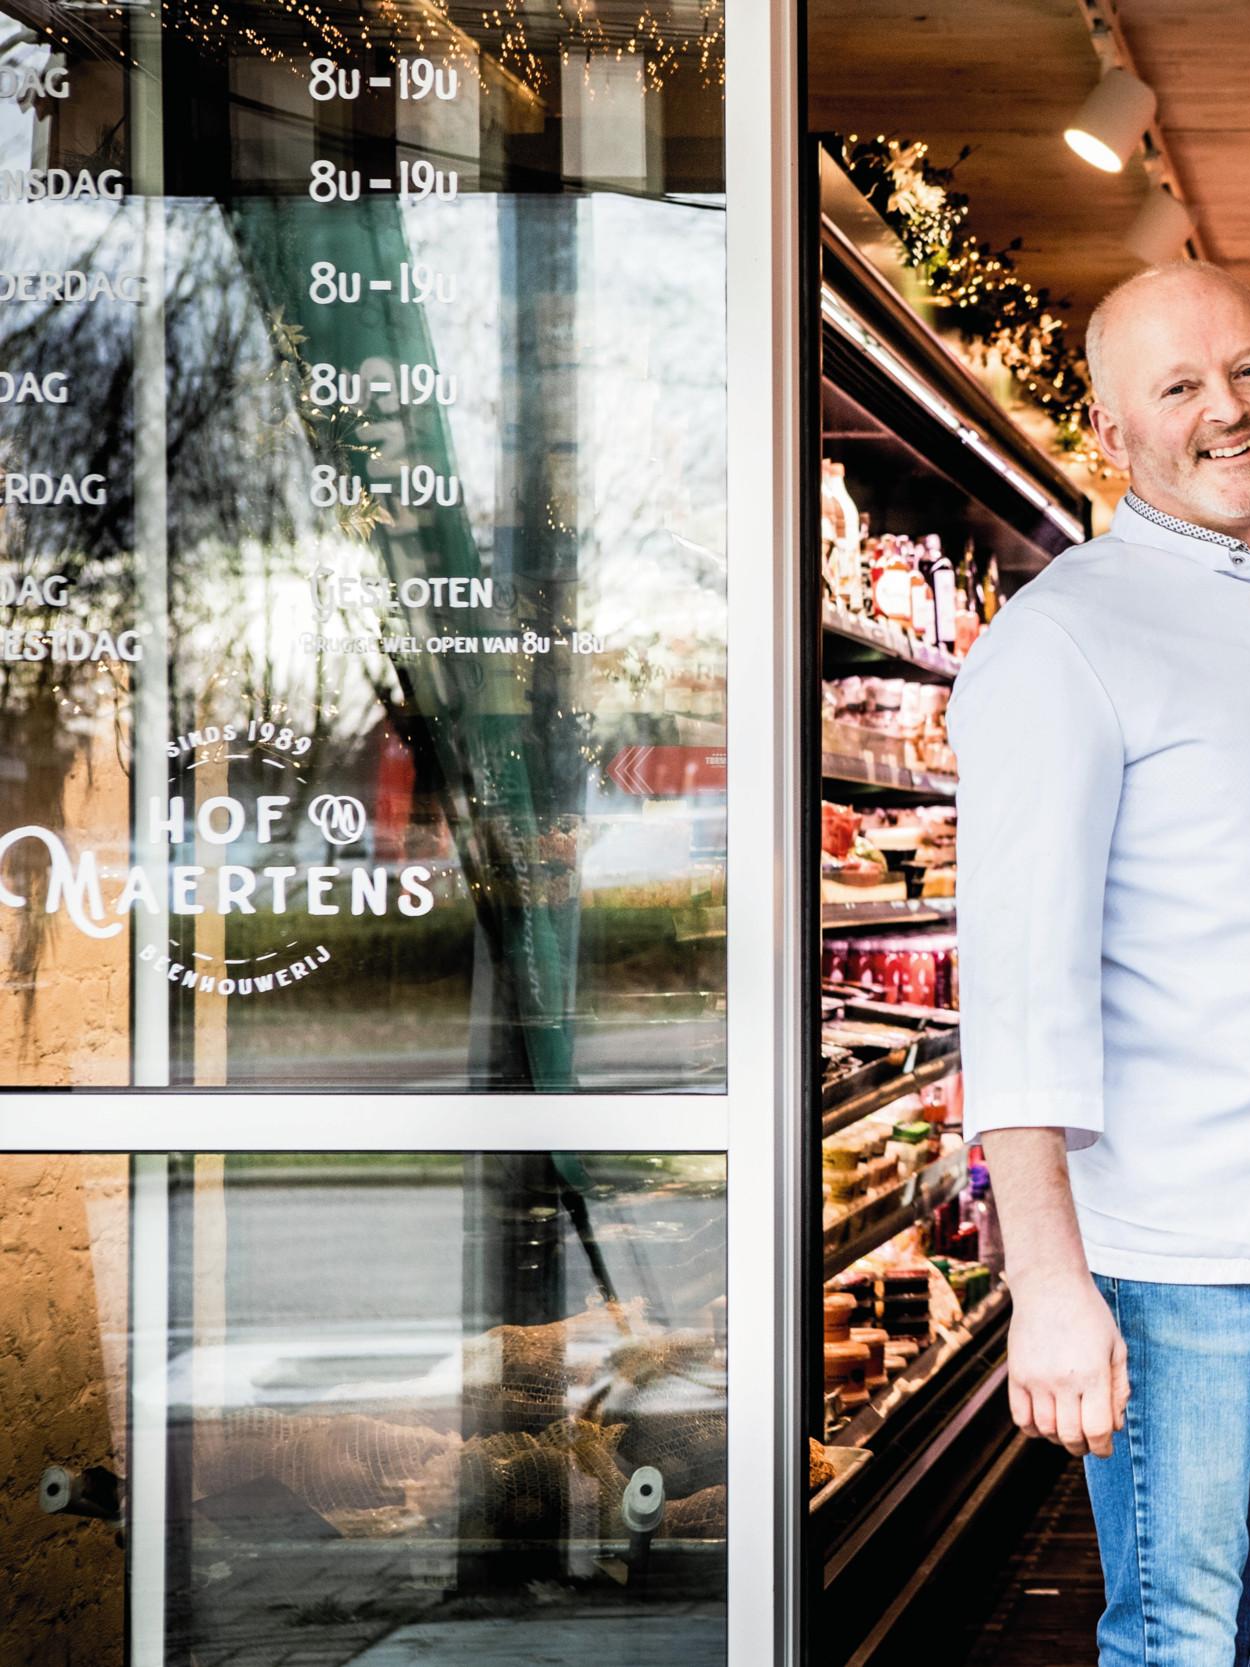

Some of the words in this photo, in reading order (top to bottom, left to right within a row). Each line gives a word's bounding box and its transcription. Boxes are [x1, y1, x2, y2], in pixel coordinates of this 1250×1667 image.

[0, 167, 124, 201] NSDAG
[0, 473, 107, 506] RDAG
[0, 629, 143, 662] ESTDAG
[383, 636, 422, 655] WEL
[426, 636, 478, 655] OPEN
[482, 636, 518, 655] VAN
[166, 723, 237, 759] SINDS
[247, 720, 312, 755] 1989
[150, 795, 291, 845] HOF
[0, 825, 435, 939] MAERTENS
[138, 943, 332, 996] BEENHOUWERIJ
